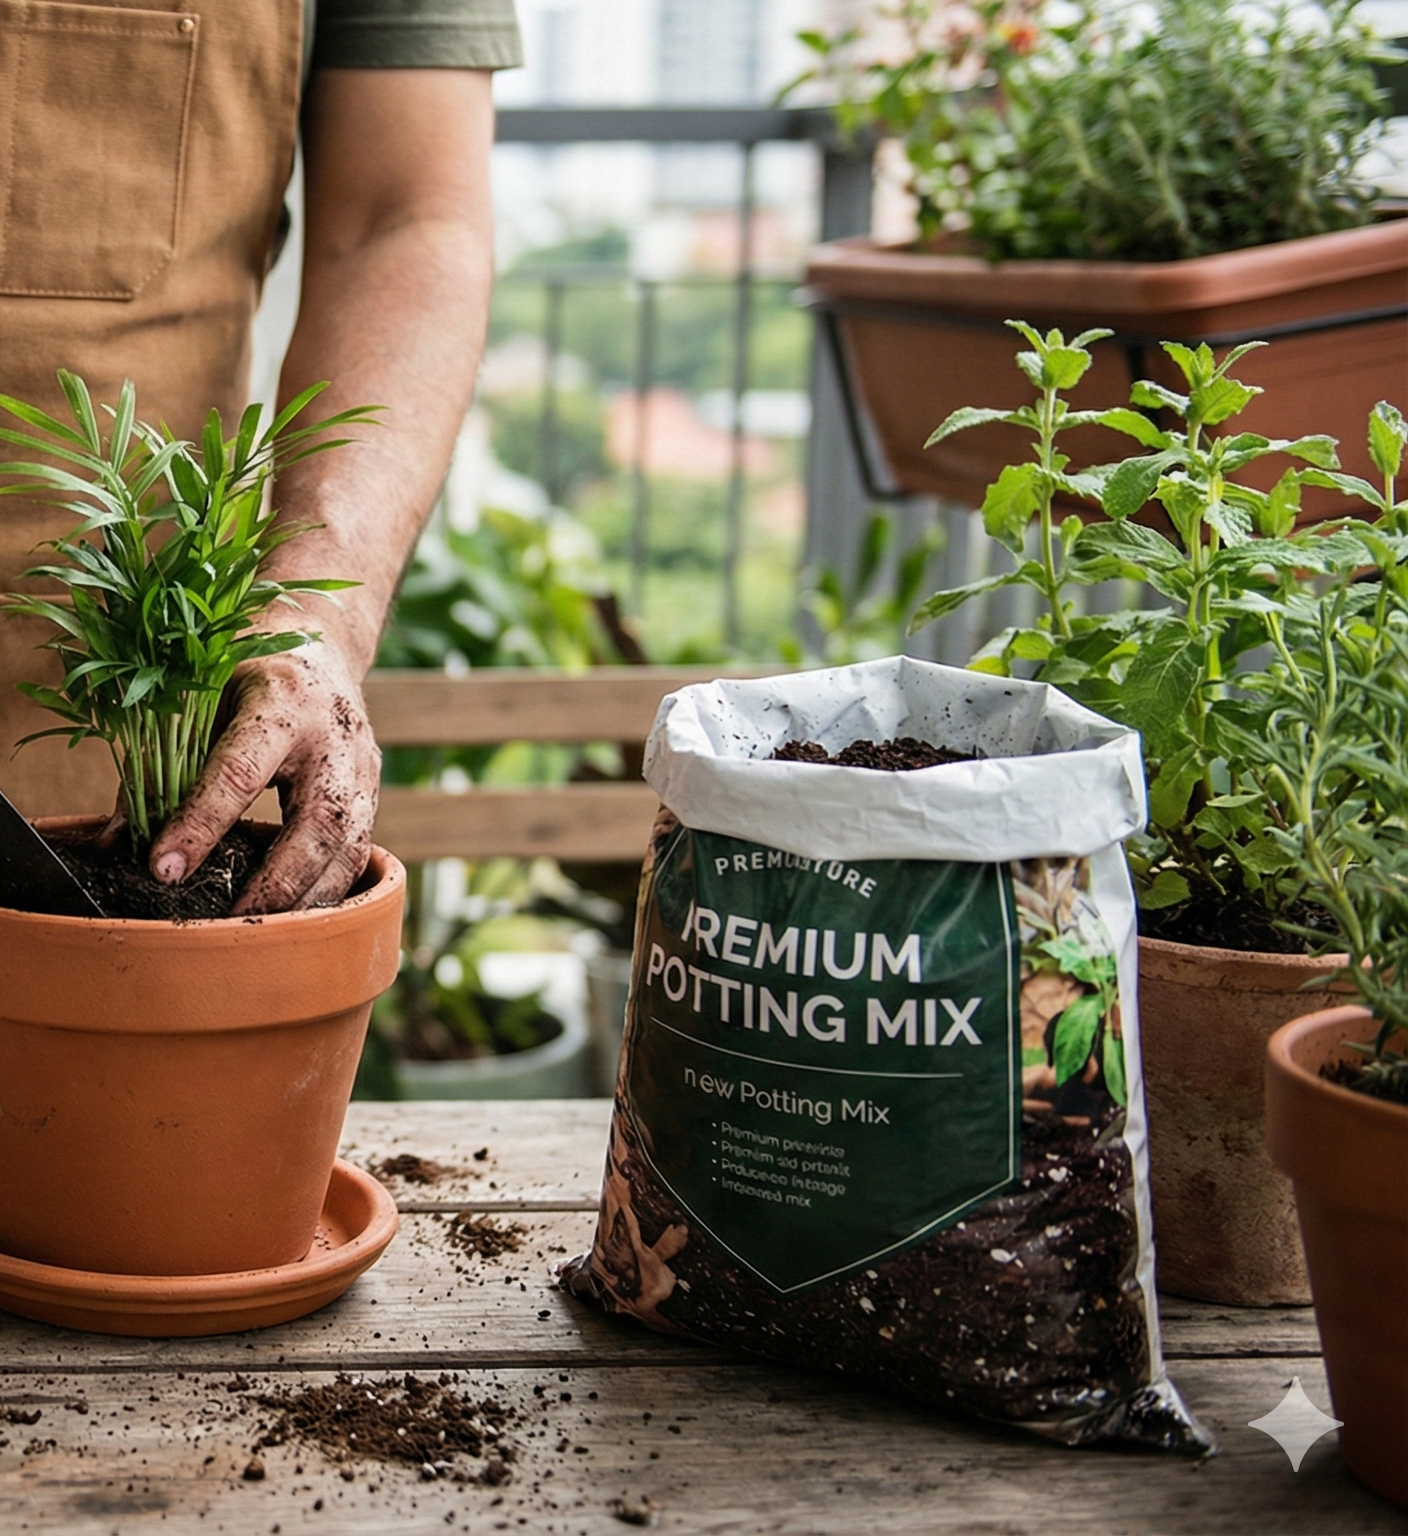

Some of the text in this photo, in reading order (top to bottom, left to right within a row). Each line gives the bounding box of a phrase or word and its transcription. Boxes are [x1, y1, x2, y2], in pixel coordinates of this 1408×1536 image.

[646, 942, 983, 1047] POTTING MIX
[740, 1081, 832, 1125] Potting
[842, 1098, 890, 1125] Mix
